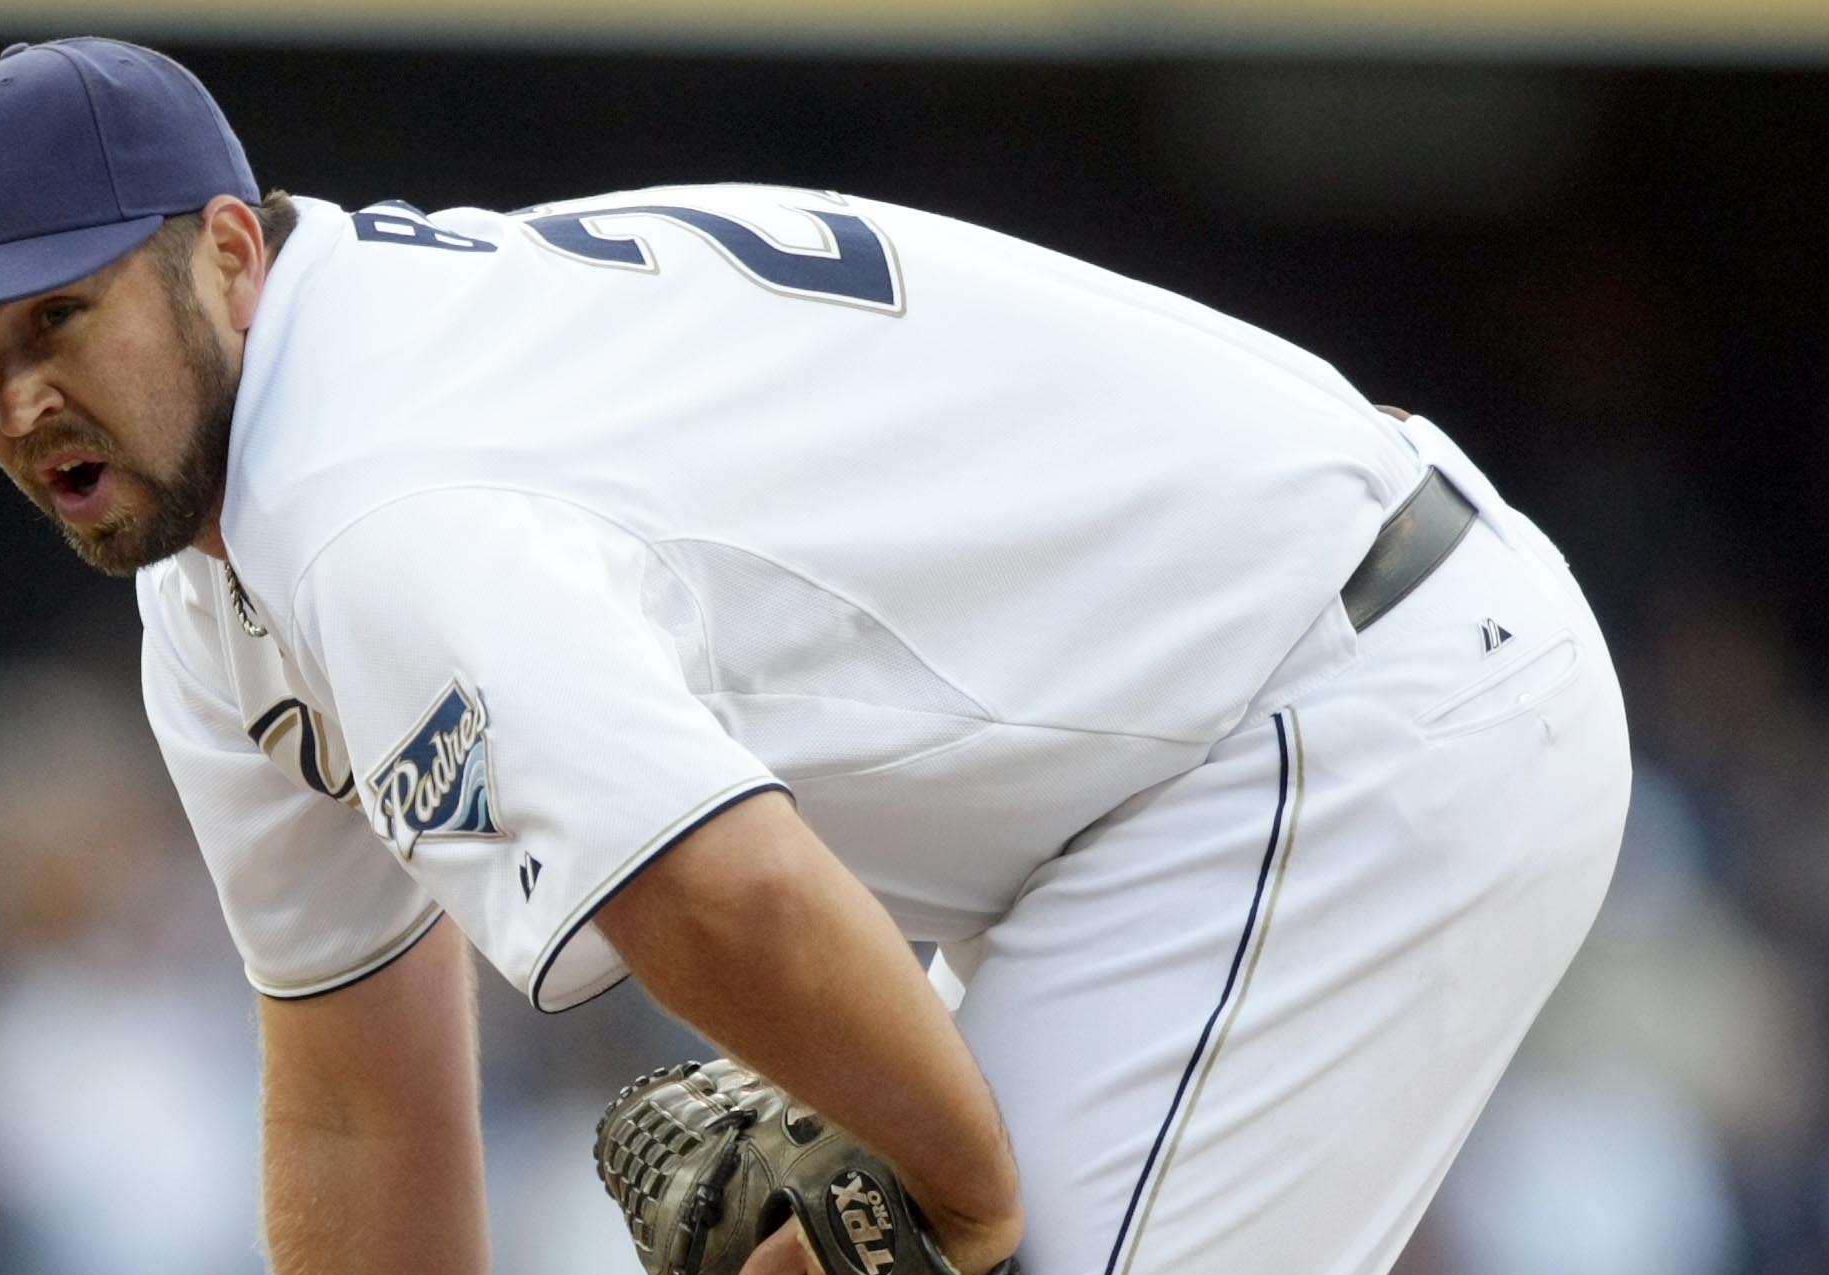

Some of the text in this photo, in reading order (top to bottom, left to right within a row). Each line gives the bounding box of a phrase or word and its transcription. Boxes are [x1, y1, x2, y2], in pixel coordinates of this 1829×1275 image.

[373, 688, 488, 863] Padres
[831, 1176, 894, 1275] TPX
[867, 1191, 892, 1230] PRO
